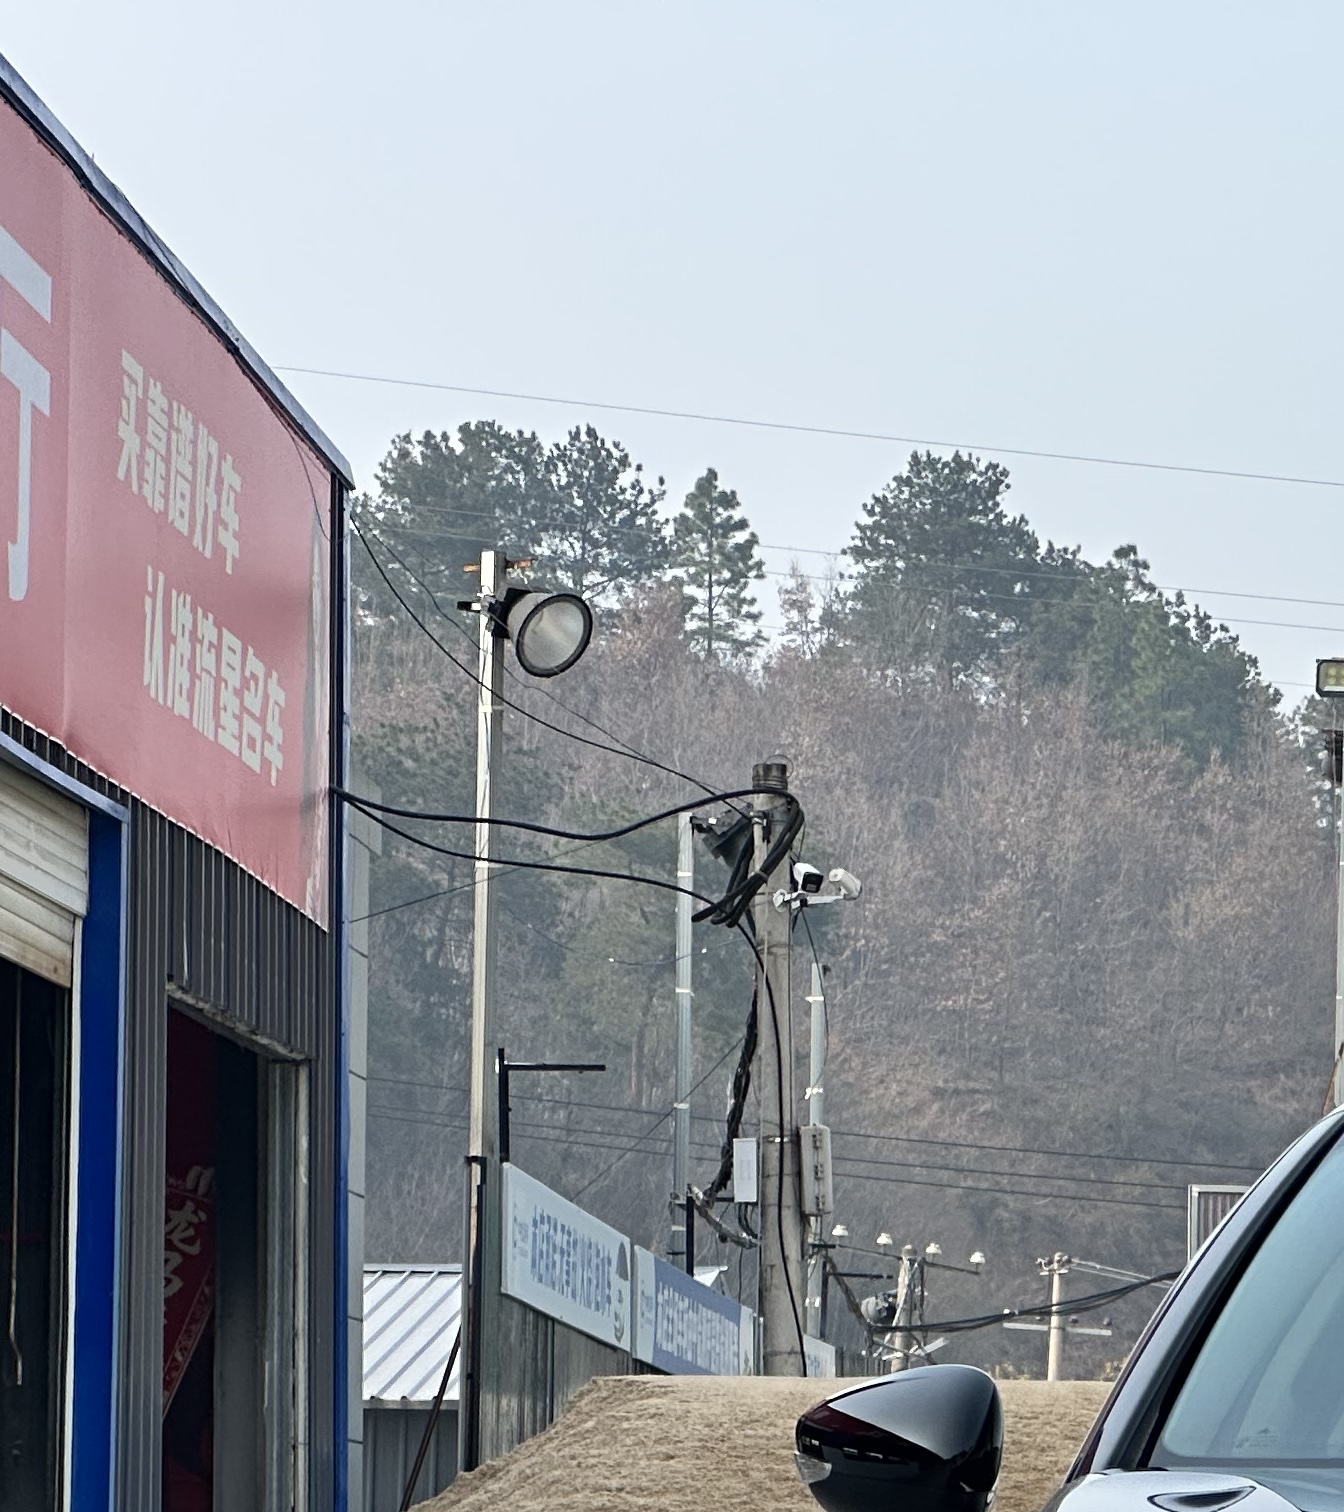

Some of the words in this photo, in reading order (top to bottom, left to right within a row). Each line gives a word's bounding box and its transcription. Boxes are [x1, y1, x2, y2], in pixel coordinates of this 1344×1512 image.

[116, 348, 242, 575] 买靠谱好车
[143, 565, 288, 786] 认准流星名车
